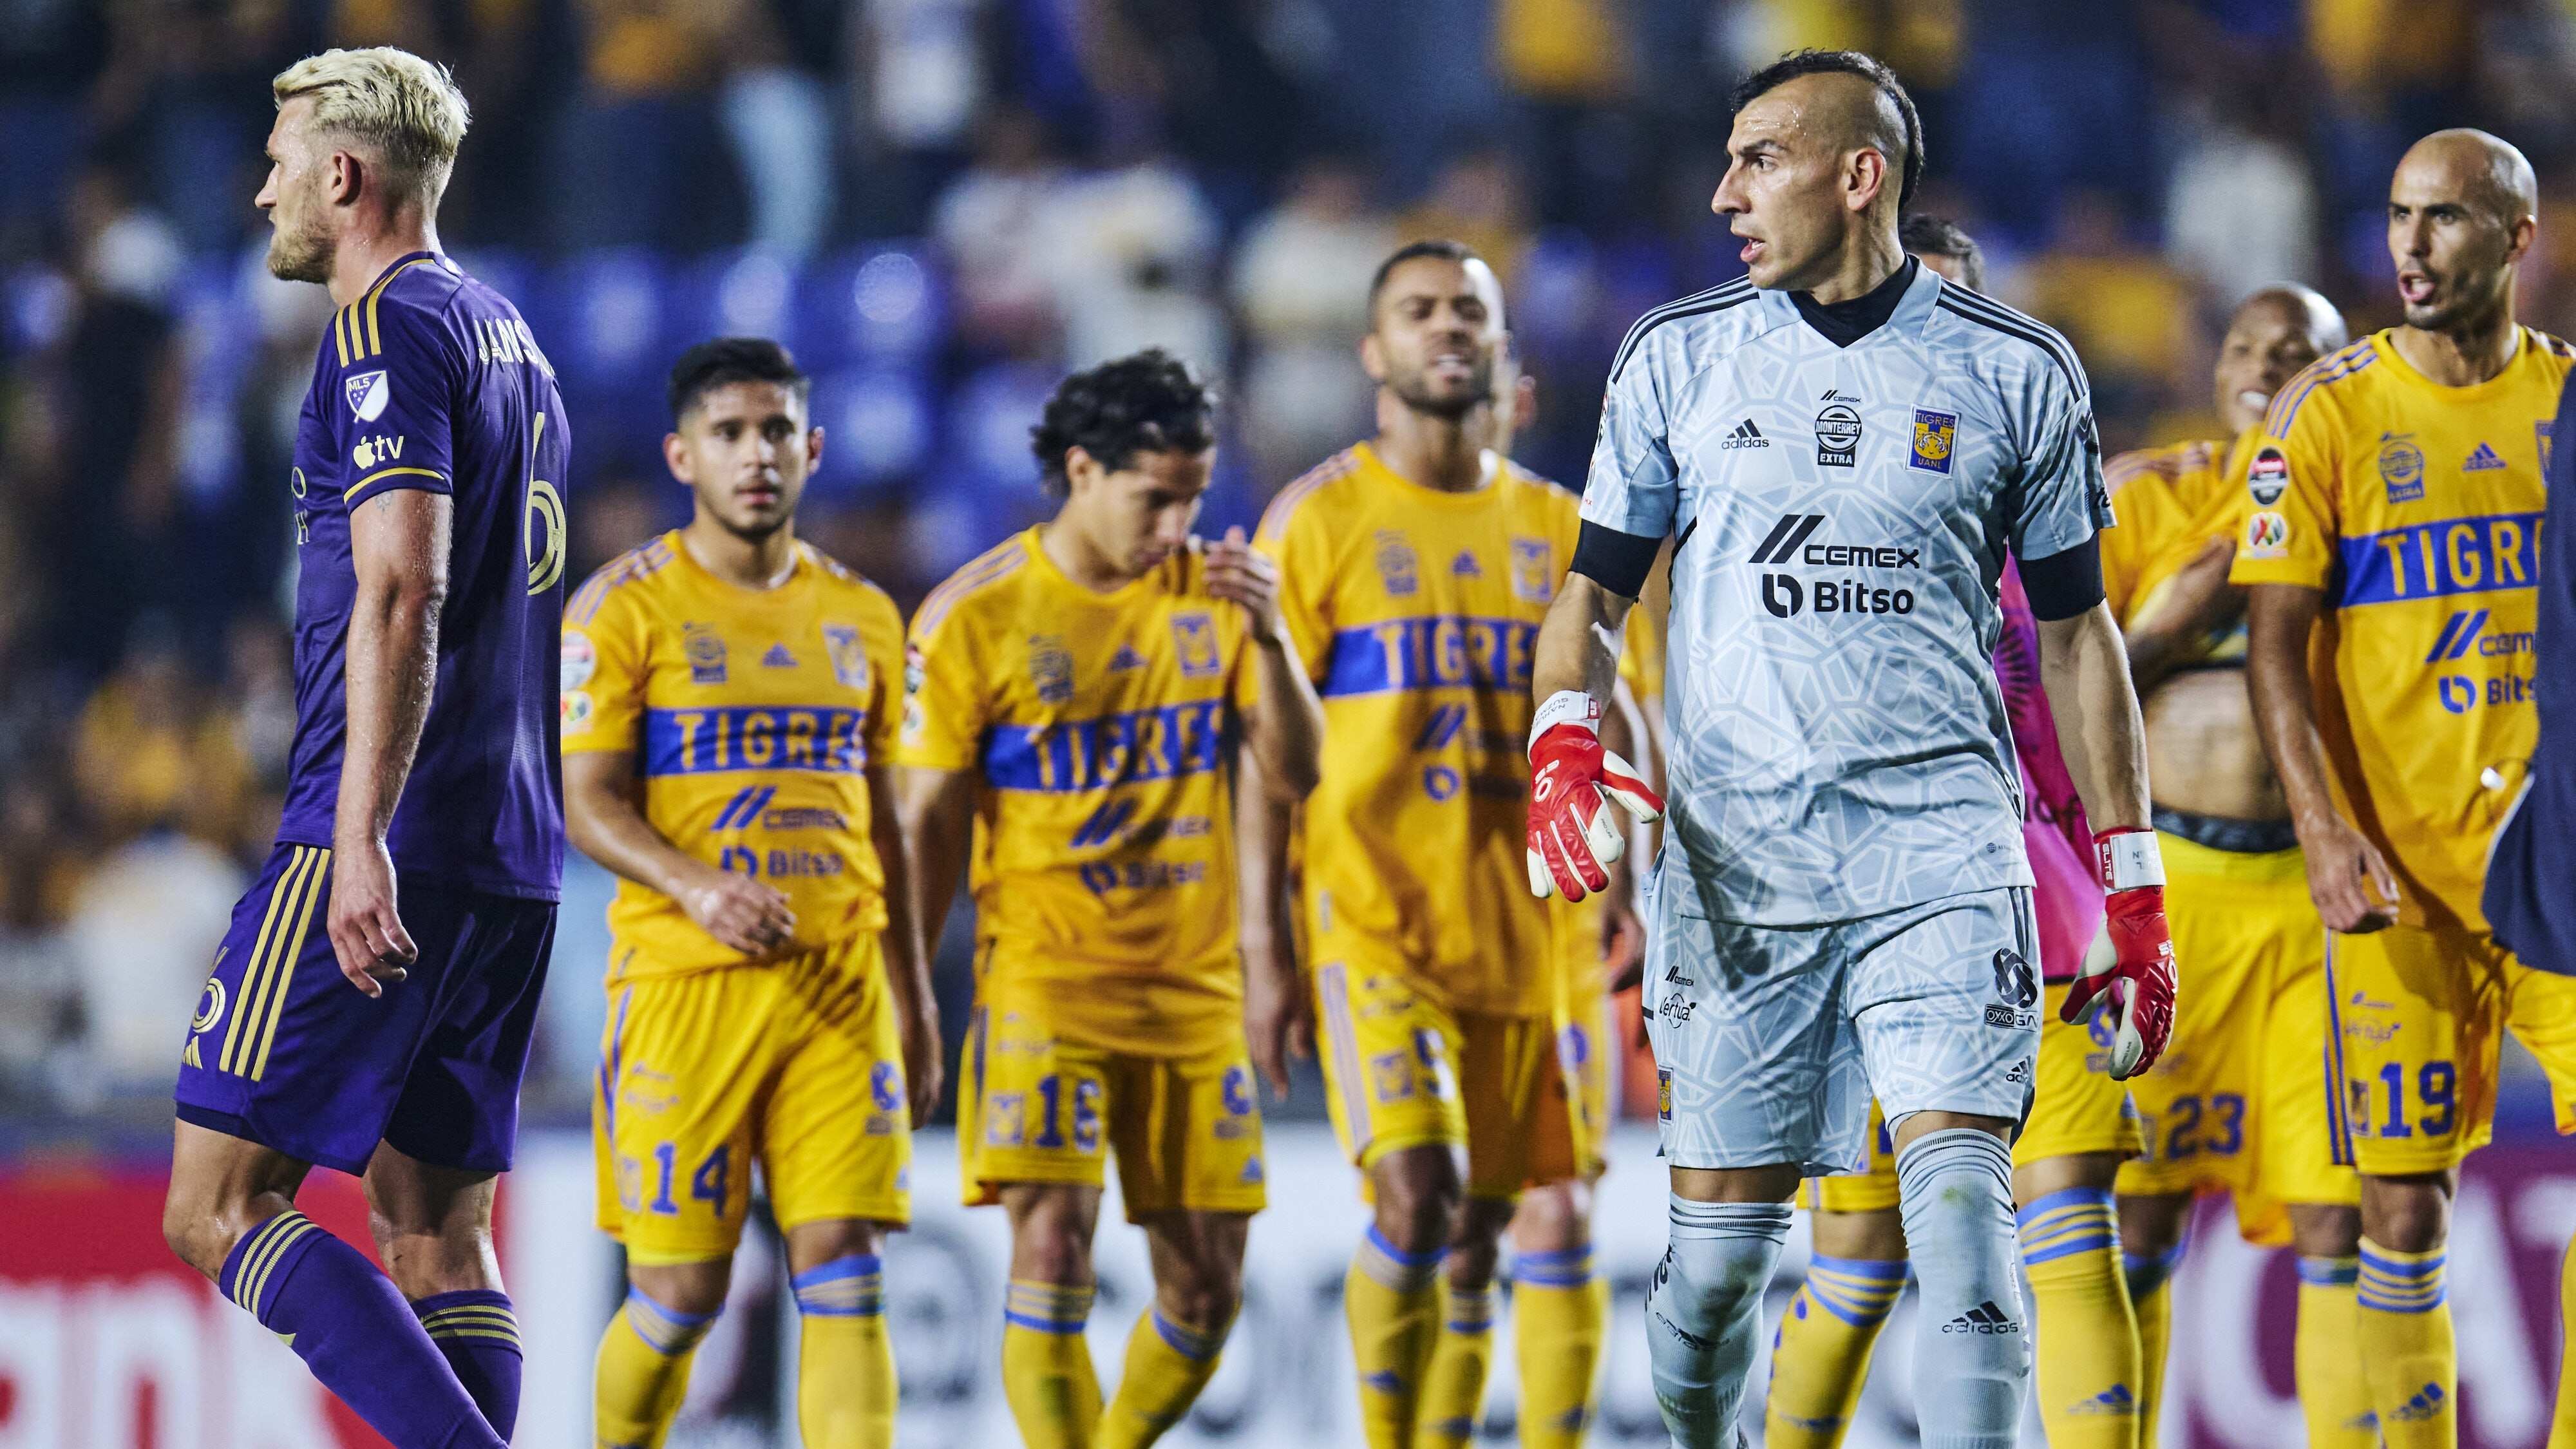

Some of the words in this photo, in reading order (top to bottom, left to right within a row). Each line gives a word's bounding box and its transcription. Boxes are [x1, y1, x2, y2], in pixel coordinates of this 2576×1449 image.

[474, 318, 554, 376] JANS
[348, 377, 371, 392] MLS
[1815, 421, 1861, 436] MONTERREY
[1916, 412, 1955, 428] TIGRES
[374, 435, 404, 462] tv
[1721, 437, 1770, 450] adidas
[1819, 453, 1853, 464] EXTRA
[1918, 457, 1942, 469] UANL
[1804, 544, 1920, 569] CEMEX
[2377, 518, 2543, 596] TIGR
[1814, 579, 1914, 614] Bitso
[1374, 620, 1537, 687] TIGRE
[2487, 673, 2535, 705] Bit
[1987, 1010, 2014, 1024] OXXO
[2380, 1061, 2456, 1138] 19
[2168, 1094, 2244, 1160] 23
[650, 1142, 728, 1217] 14
[1942, 1321, 2019, 1335] adidas
